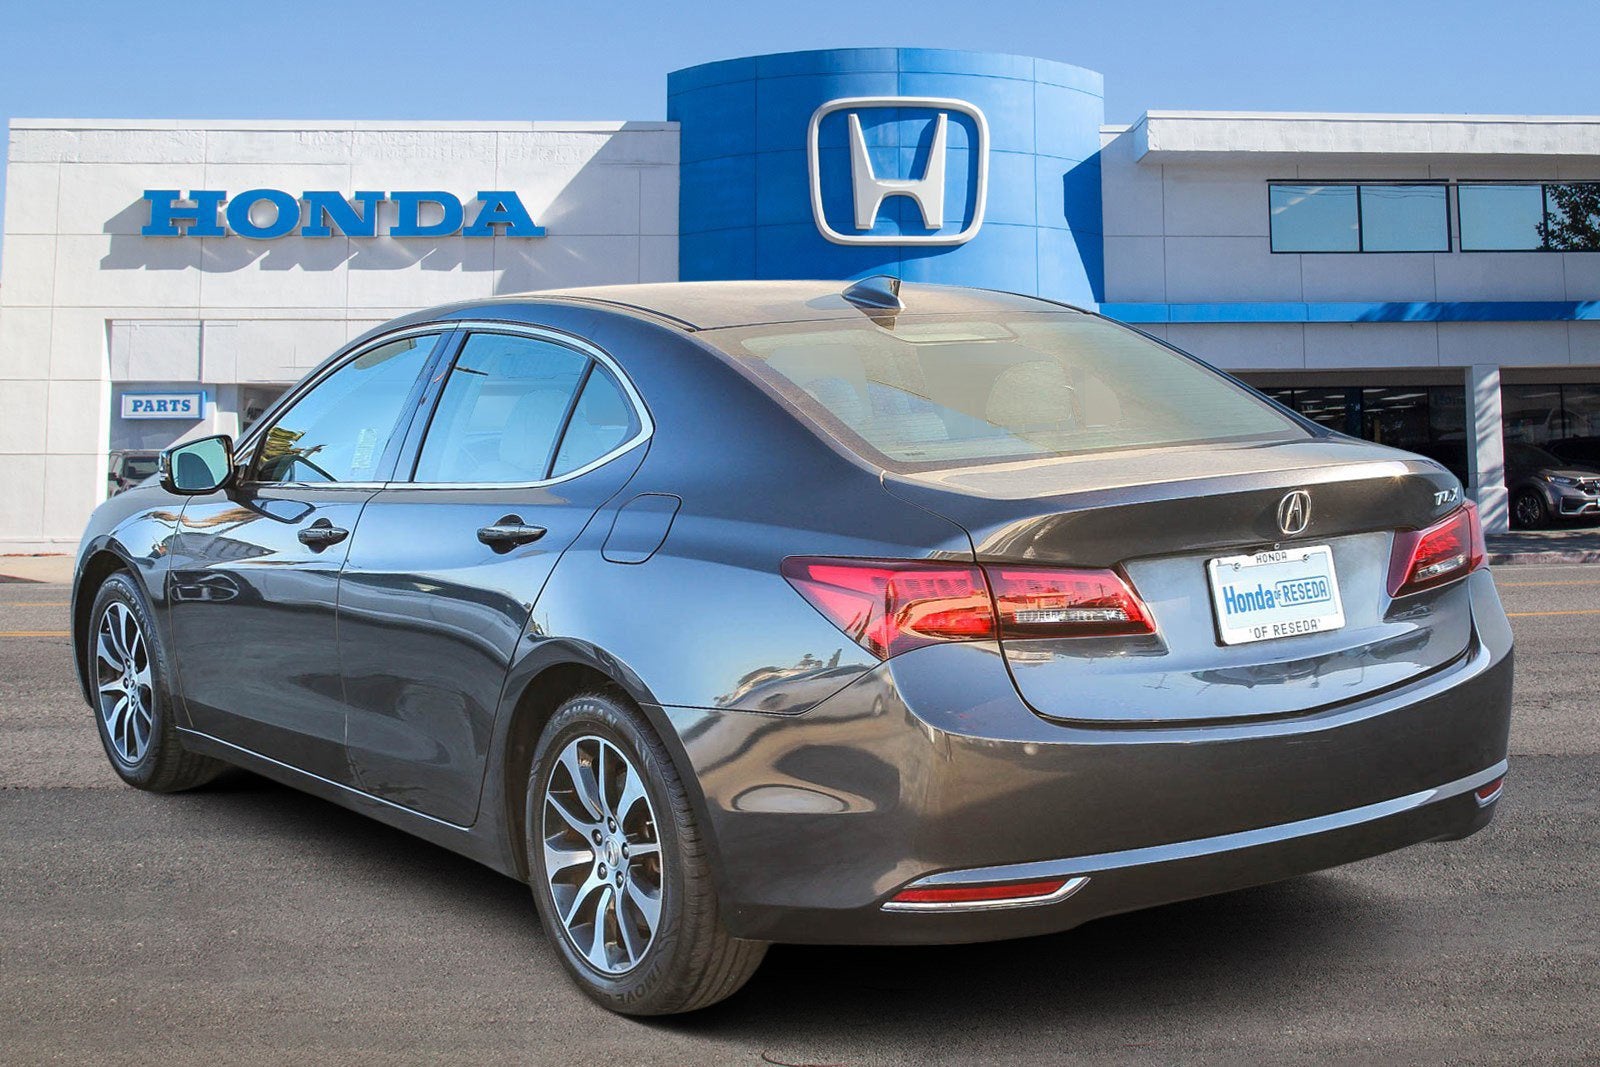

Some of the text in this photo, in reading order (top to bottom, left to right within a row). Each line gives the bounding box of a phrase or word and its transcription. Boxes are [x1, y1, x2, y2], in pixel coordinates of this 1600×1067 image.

[142, 189, 547, 239] HONDA
[132, 400, 191, 412] PARTS
[1256, 551, 1287, 564] HONDA
[1222, 584, 1275, 615] Honda
[1282, 581, 1328, 603] RESEDA
